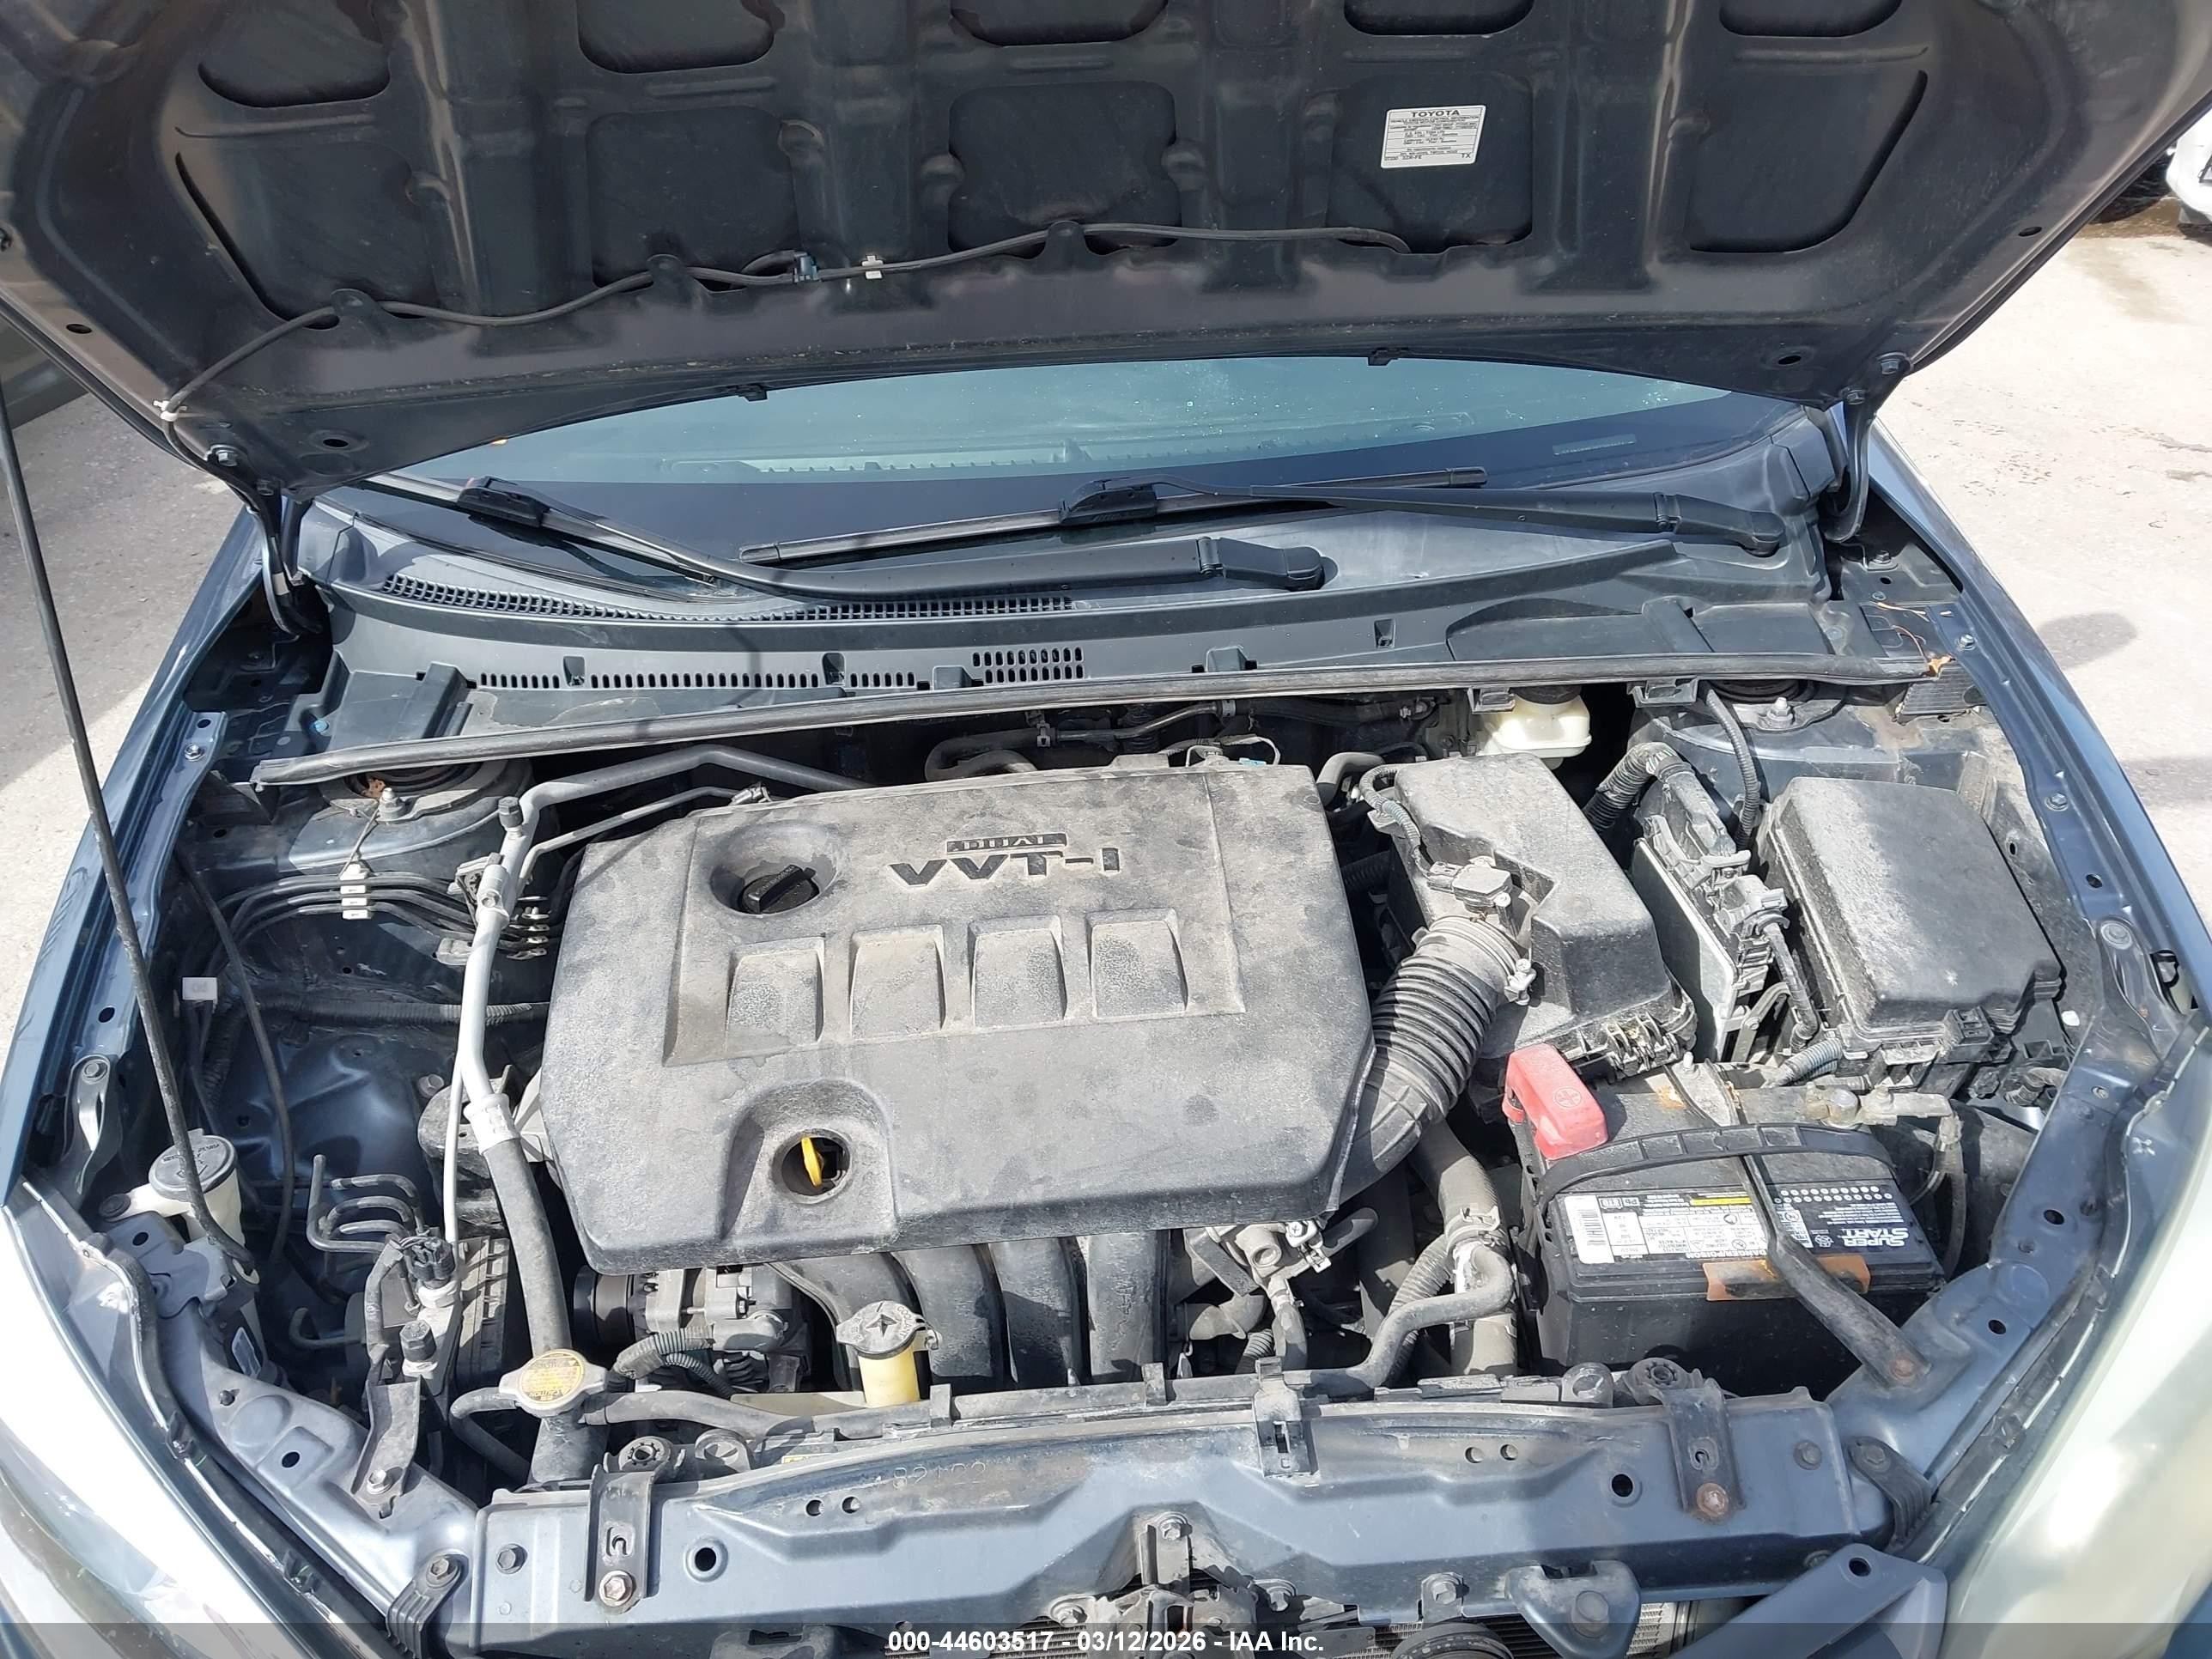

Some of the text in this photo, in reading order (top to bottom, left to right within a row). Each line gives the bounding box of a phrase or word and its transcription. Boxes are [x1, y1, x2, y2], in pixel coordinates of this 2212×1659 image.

[1841, 1228, 1909, 1239] START
[1844, 1237, 1905, 1247] SUPER
[1686, 1249, 1767, 1259] DANGER/POISON
[896, 1305, 913, 1339] COOLANT
